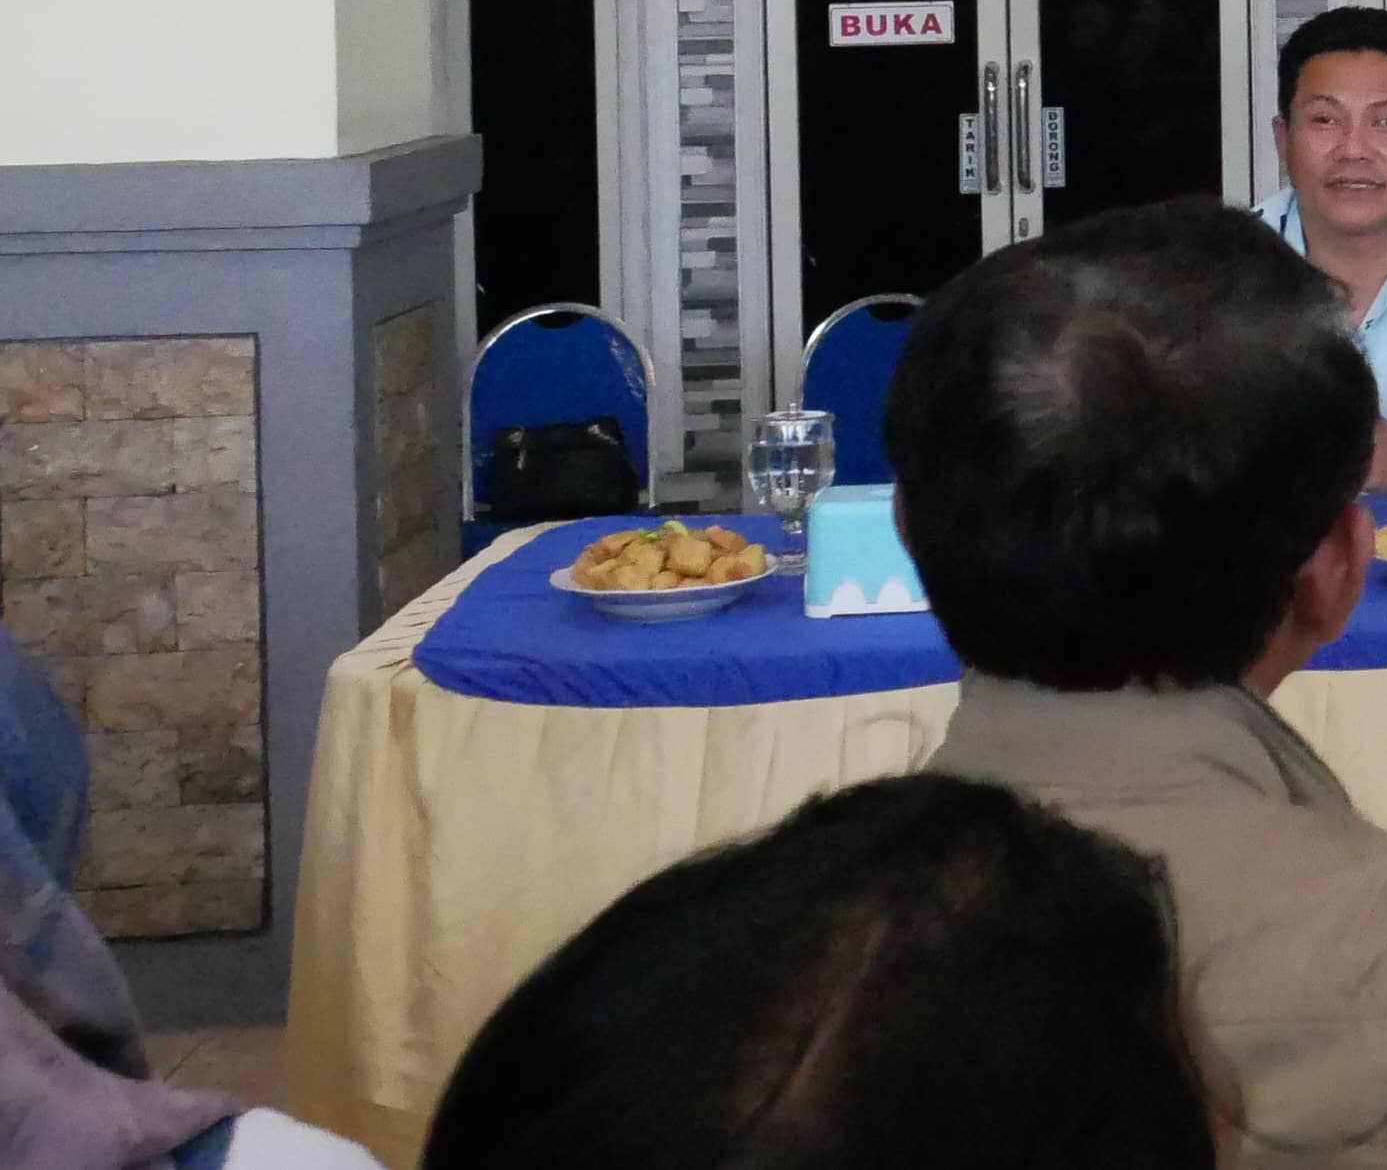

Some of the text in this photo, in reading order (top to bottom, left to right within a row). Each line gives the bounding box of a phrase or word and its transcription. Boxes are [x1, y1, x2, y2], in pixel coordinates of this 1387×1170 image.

[840, 13, 943, 37] BUKA
[965, 119, 975, 177] TARIK
[1047, 111, 1060, 172] DORONG
